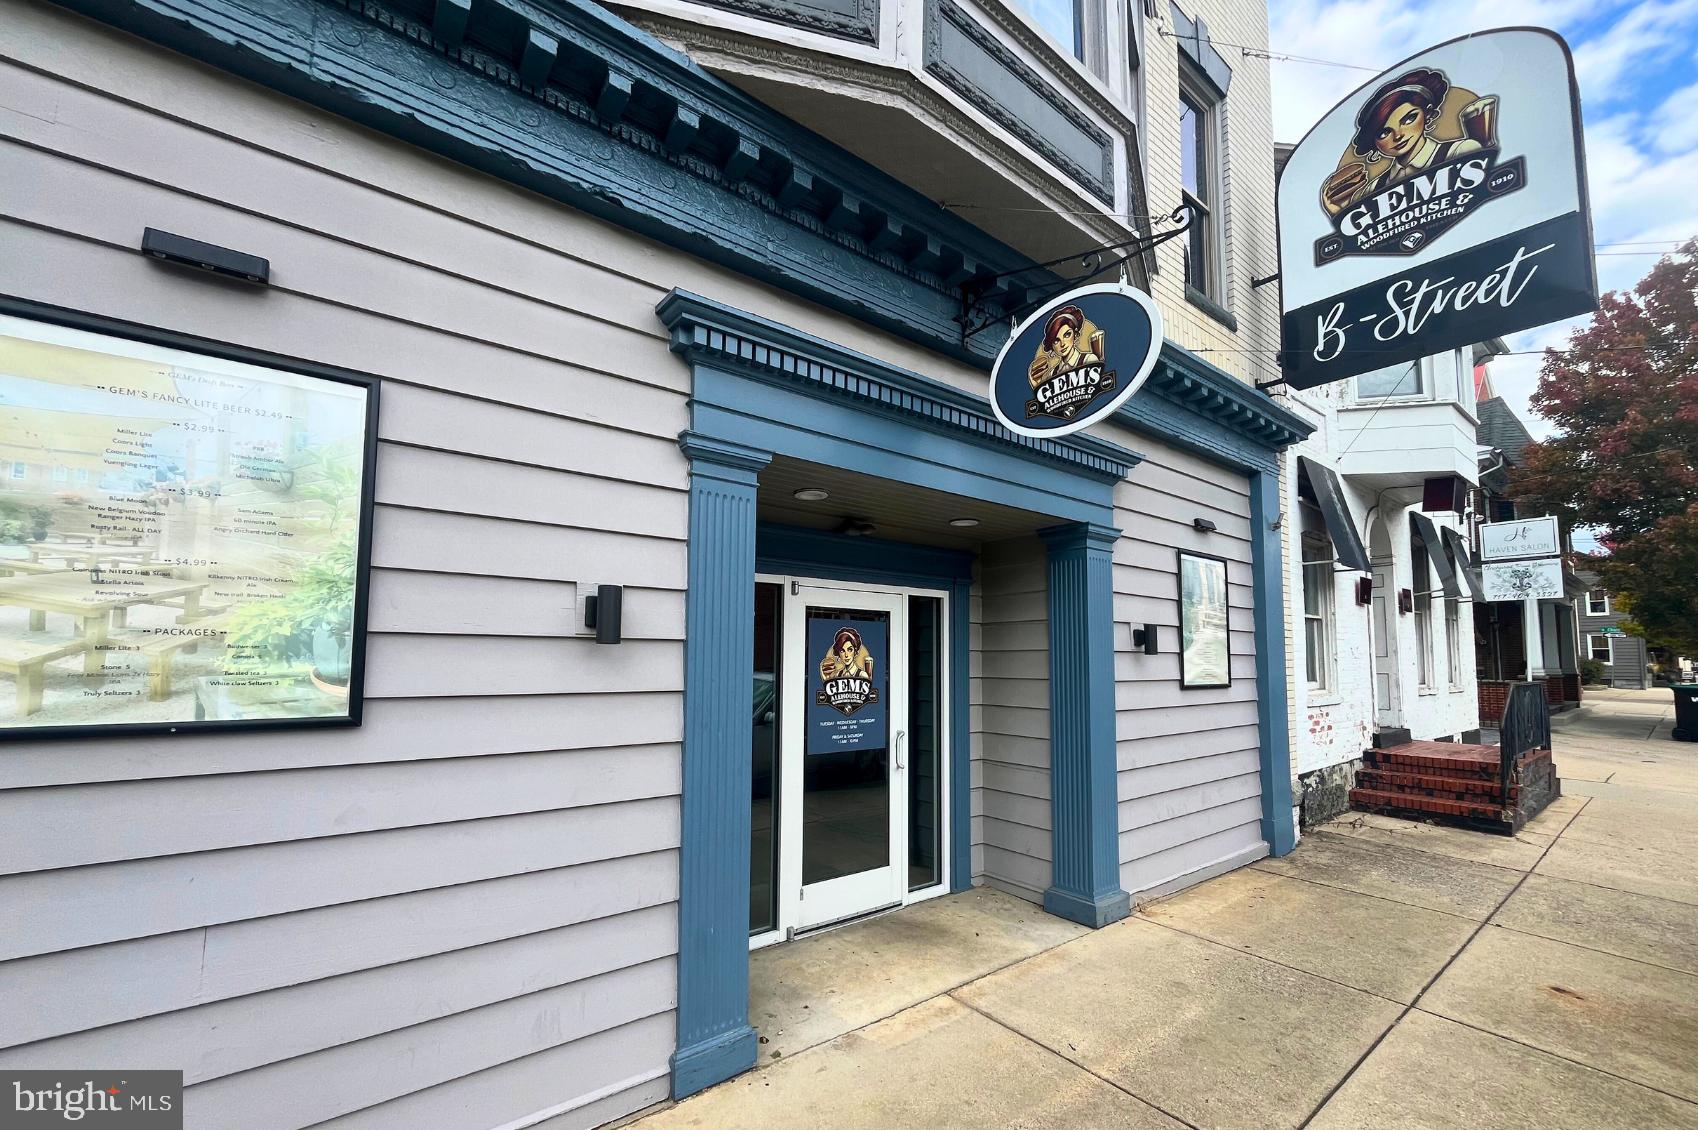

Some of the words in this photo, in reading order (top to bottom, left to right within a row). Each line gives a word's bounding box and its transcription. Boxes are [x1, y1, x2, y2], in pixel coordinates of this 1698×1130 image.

[1491, 173, 1514, 187] 1910
[1341, 158, 1488, 237] GEM'S
[1356, 197, 1451, 246] ALEHOUSE
[1456, 192, 1474, 204] &
[1361, 221, 1418, 250] WOODFIRED
[1420, 206, 1465, 225] KITCHEN
[1037, 367, 1102, 403] GEM'S
[110, 386, 149, 399] GEM'S
[153, 393, 191, 405] FANCY
[194, 400, 219, 410] LITE
[223, 404, 252, 415] BEER
[1044, 387, 1086, 410] ALEHOUSE
[117, 428, 138, 437] Miller
[184, 422, 216, 434] $2.99
[112, 438, 134, 446] Coors
[106, 448, 127, 456] Coors
[129, 451, 159, 459] Banquet
[180, 488, 212, 498] $3.99
[108, 506, 137, 515] Belgium
[98, 513, 123, 521] Ranger
[1490, 546, 1518, 554] HAVEN
[1521, 543, 1550, 552] SALON
[176, 558, 207, 567] $4.99
[155, 628, 217, 637] PACKAGES
[826, 679, 871, 696] GEM'S
